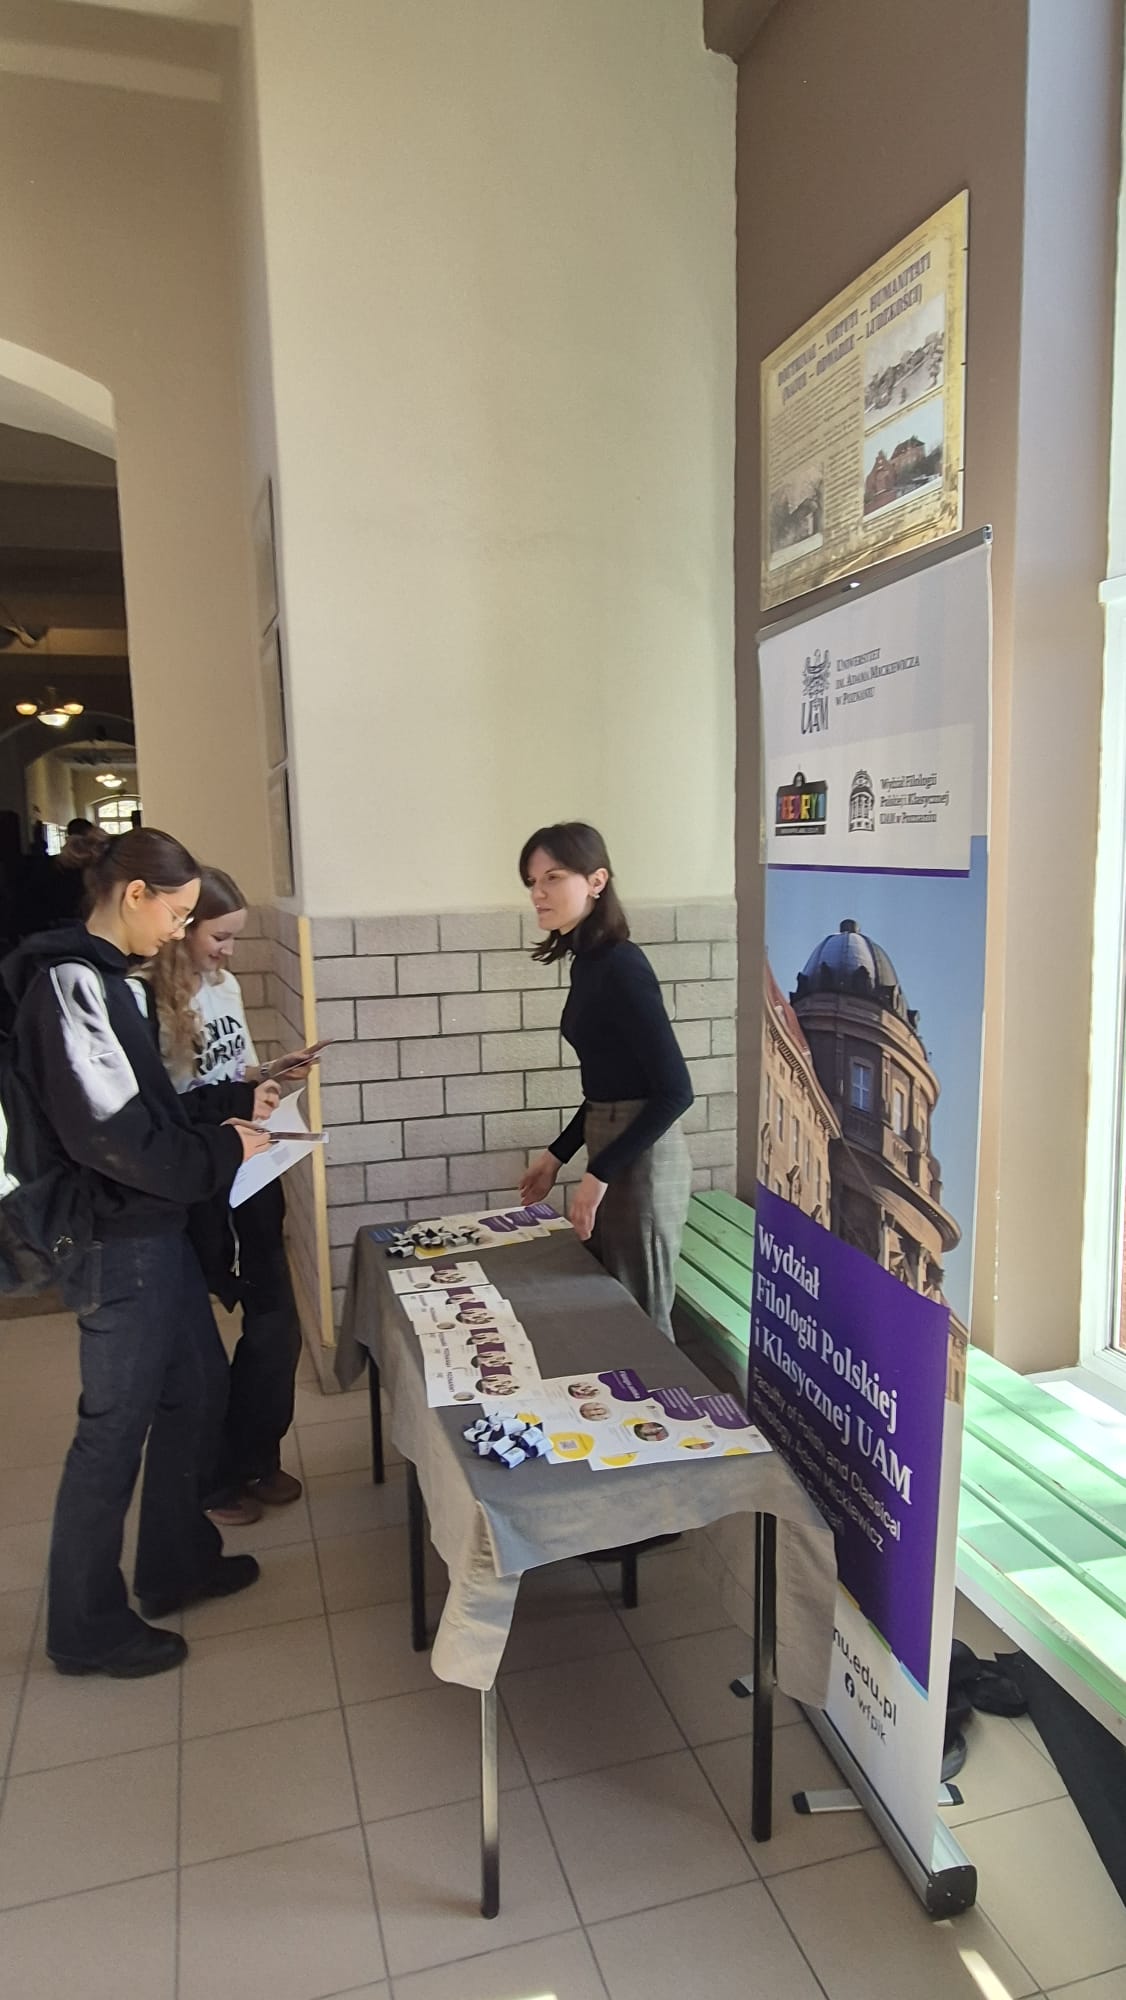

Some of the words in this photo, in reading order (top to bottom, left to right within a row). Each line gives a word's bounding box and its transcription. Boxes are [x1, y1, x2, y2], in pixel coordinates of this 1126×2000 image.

[801, 696, 828, 735] UAM
[758, 1223, 820, 1300] Wydział
[756, 1271, 817, 1352] Filologii
[820, 1328, 898, 1434] Polskiej
[754, 1317, 760, 1348] i
[762, 1326, 852, 1446] Klasycznej
[855, 1414, 914, 1506] UAM
[824, 1472, 884, 1552] Mickiewicz
[826, 1451, 848, 1481] and
[851, 1471, 900, 1541] Classical
